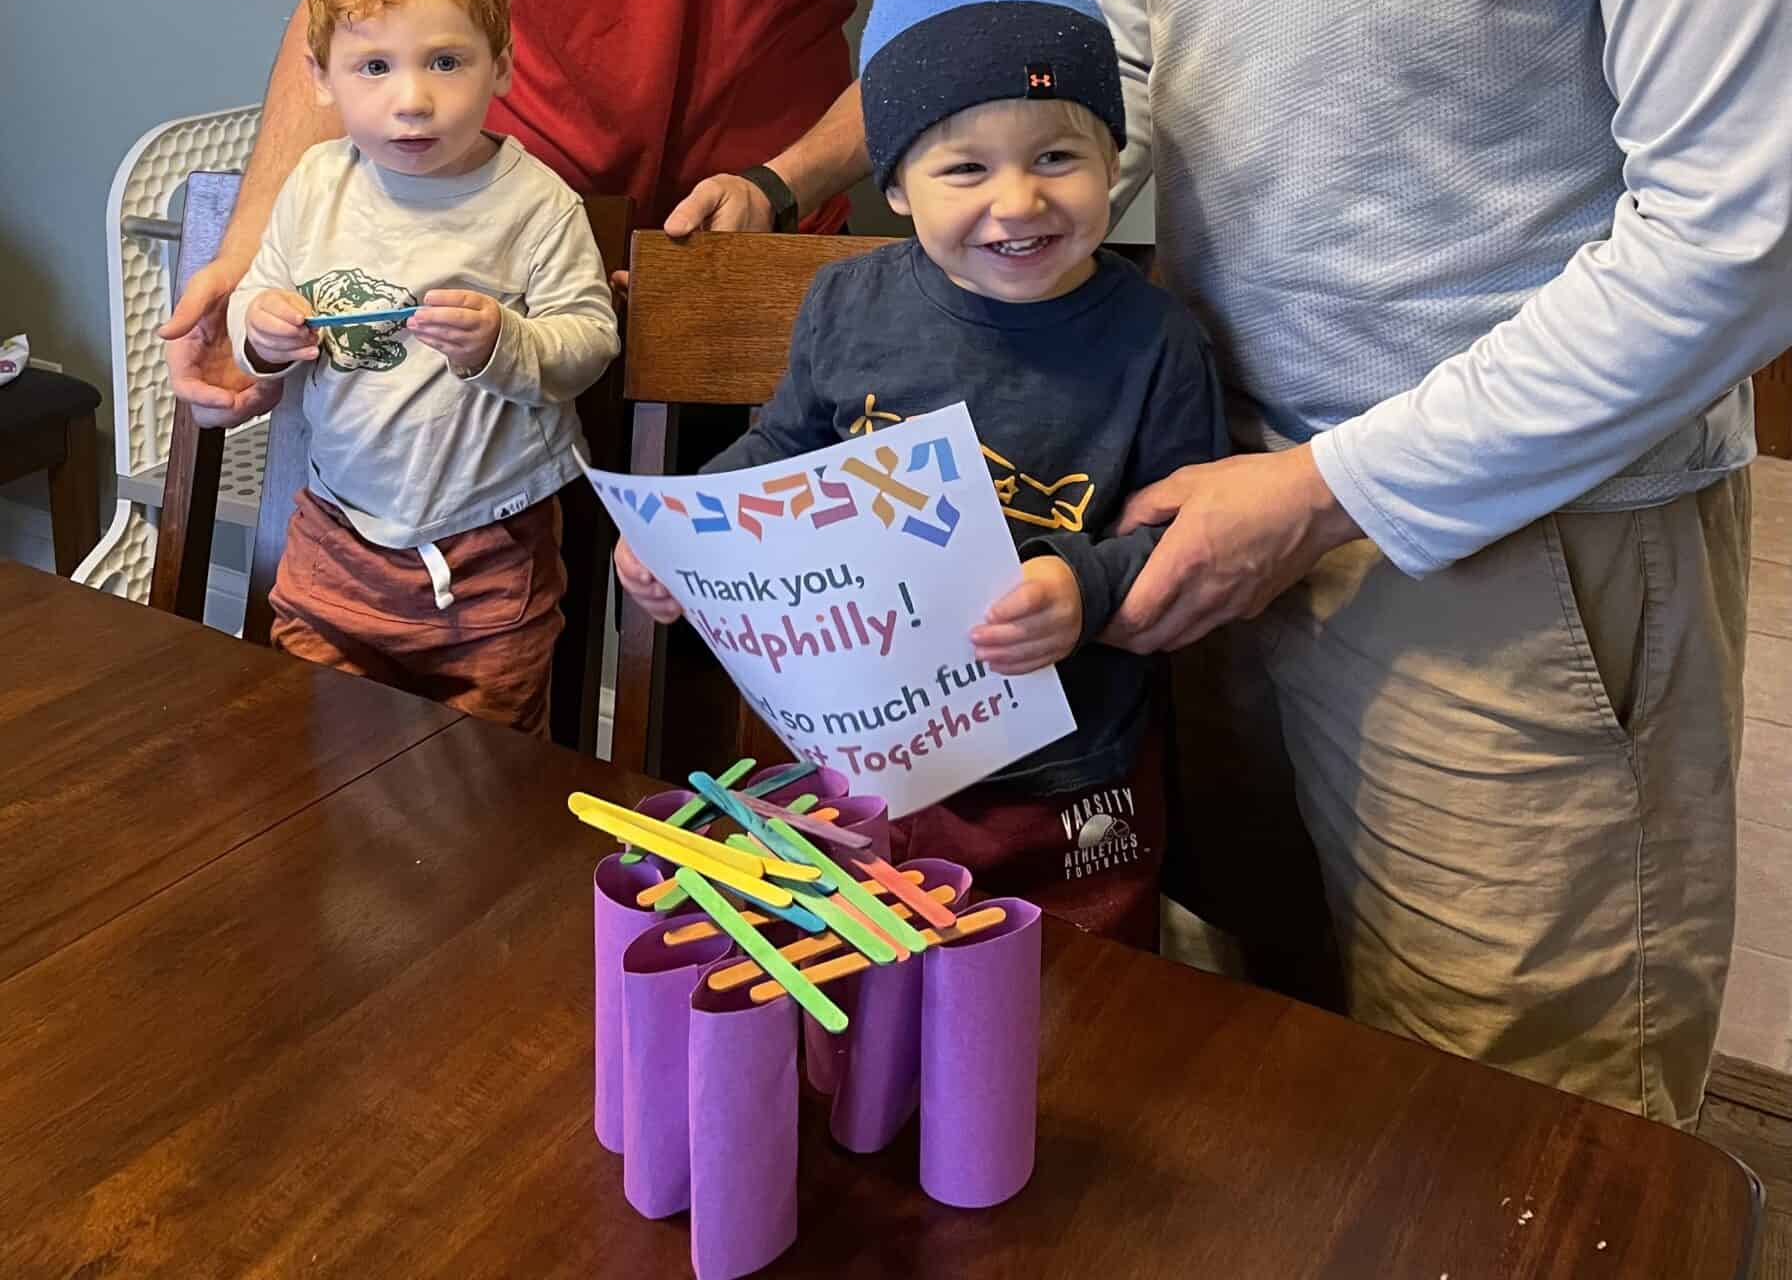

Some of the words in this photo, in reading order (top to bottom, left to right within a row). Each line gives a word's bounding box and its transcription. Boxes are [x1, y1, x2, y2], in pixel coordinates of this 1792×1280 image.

[676, 569, 778, 602] Thank
[780, 563, 865, 607] you,
[780, 709, 815, 733] so
[823, 686, 931, 735] much
[836, 679, 1019, 775] Together!
[1061, 787, 1135, 840] VARSITY
[1064, 833, 1138, 868] ATHLETICS
[1066, 849, 1138, 880] FOOTBALL
